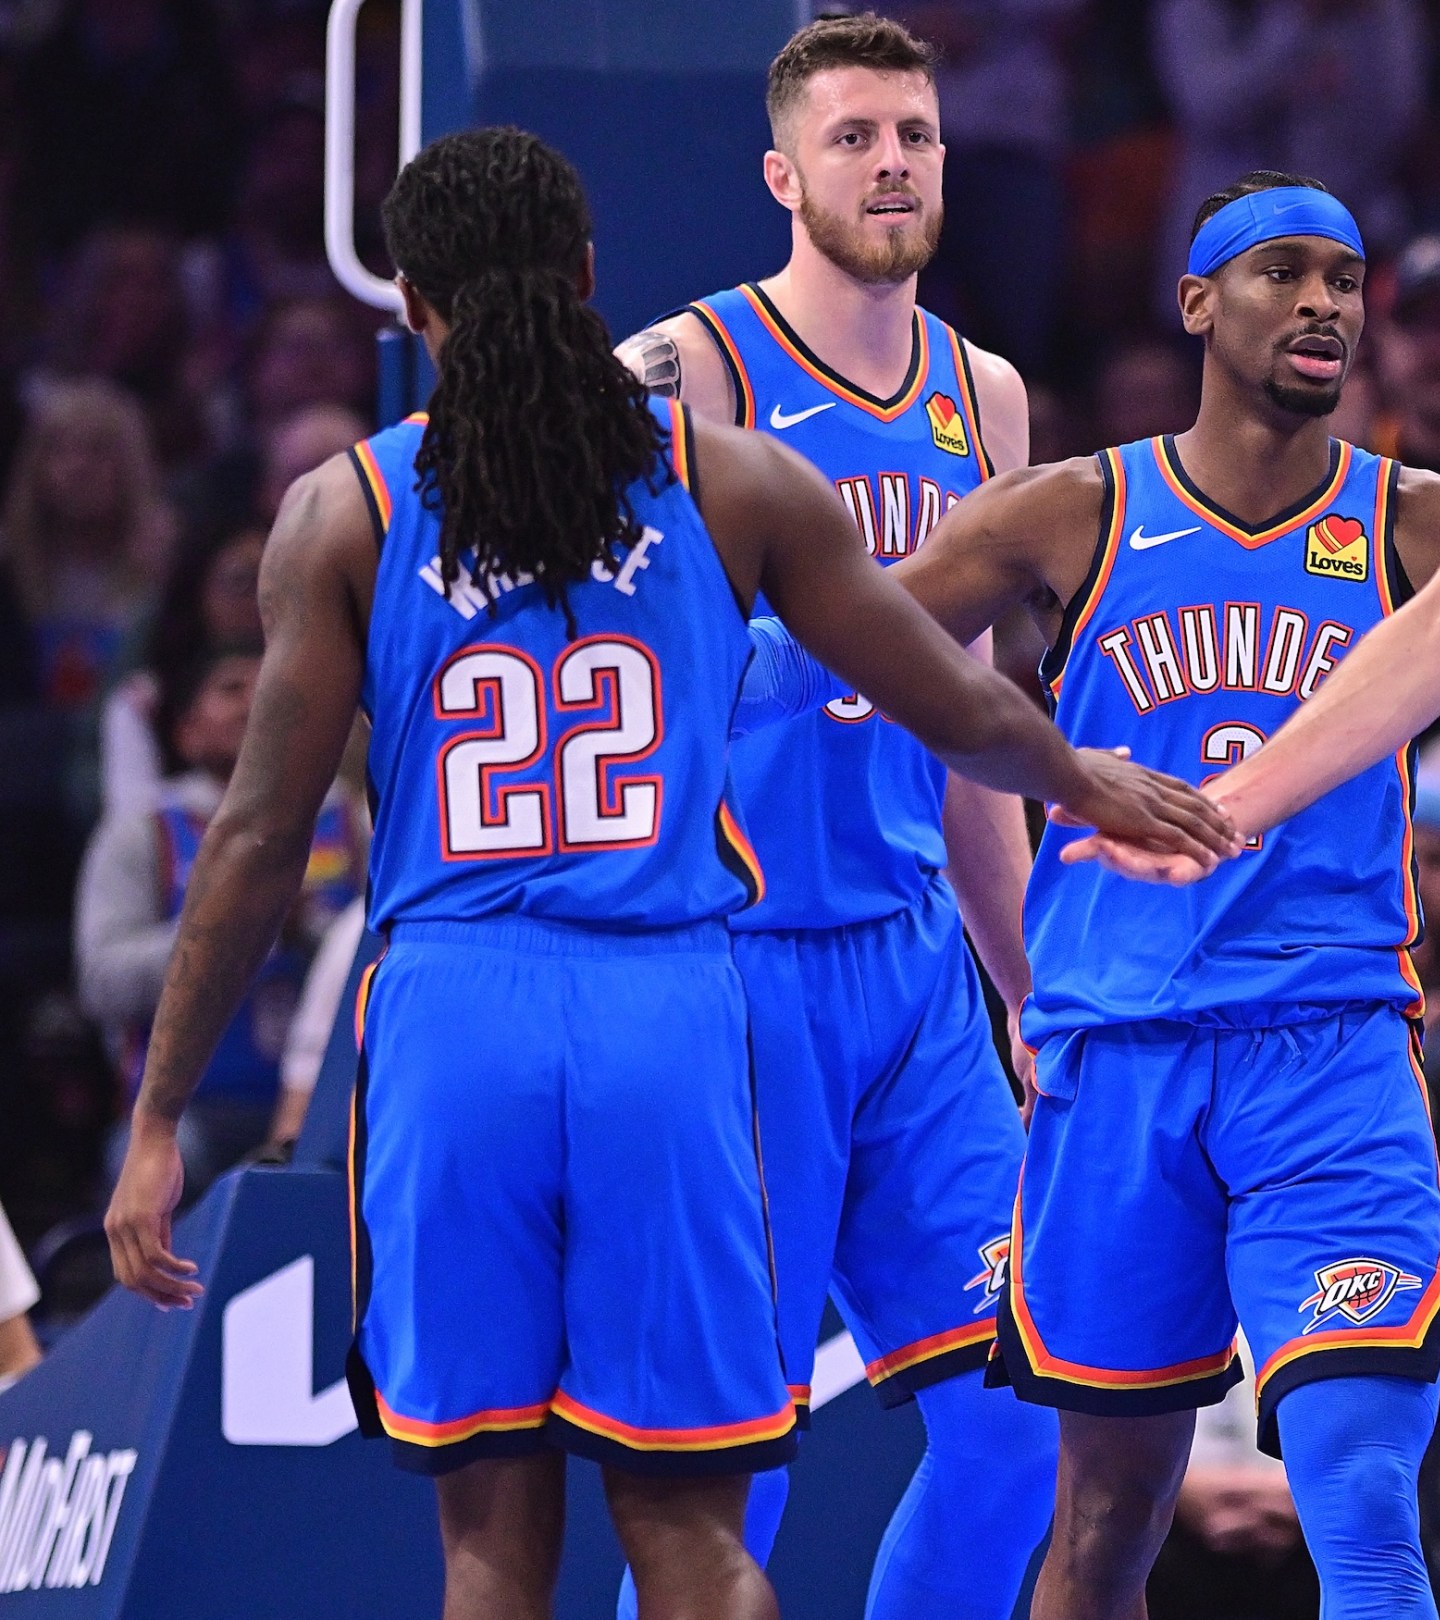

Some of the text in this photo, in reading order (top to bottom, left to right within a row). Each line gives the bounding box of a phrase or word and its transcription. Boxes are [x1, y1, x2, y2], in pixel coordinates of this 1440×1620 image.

[1097, 601, 1366, 716] THUNDE
[432, 632, 664, 862] 22
[1317, 1271, 1382, 1315] OKC
